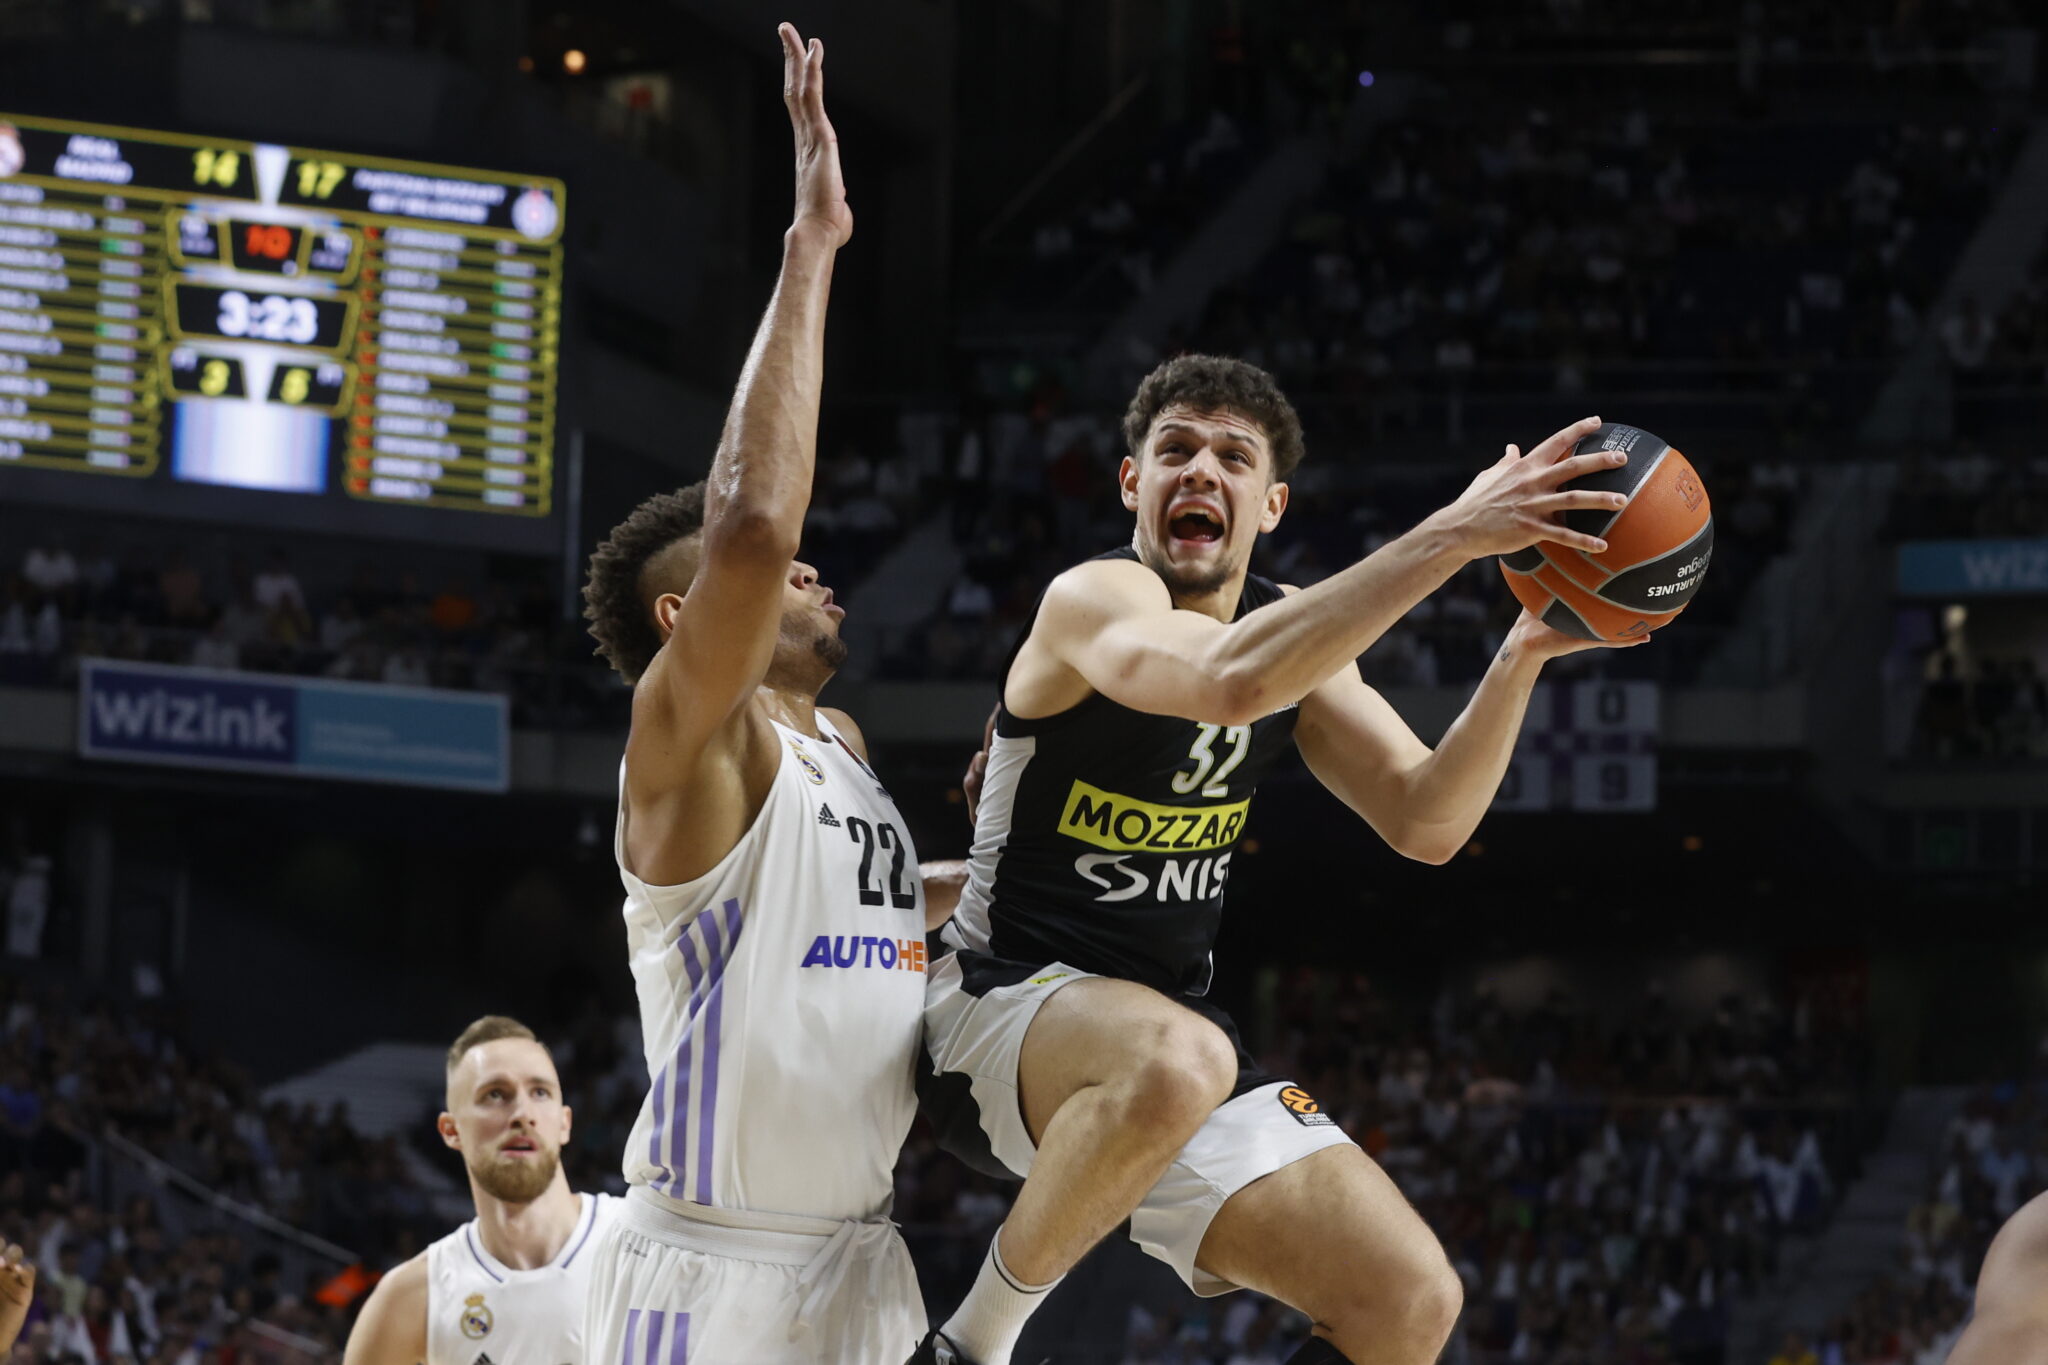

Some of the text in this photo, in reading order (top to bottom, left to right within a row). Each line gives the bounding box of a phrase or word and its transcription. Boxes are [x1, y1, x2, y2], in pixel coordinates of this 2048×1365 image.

[193, 148, 239, 188] 14
[297, 160, 346, 199] 17
[217, 291, 318, 344] 3:23
[1647, 575, 1696, 597] AIRLINES
[94, 688, 288, 751] WiZink
[1171, 722, 1251, 797] 32
[846, 816, 915, 910] 22
[1157, 852, 1232, 902] NIS
[801, 935, 928, 975] AUTOHE
